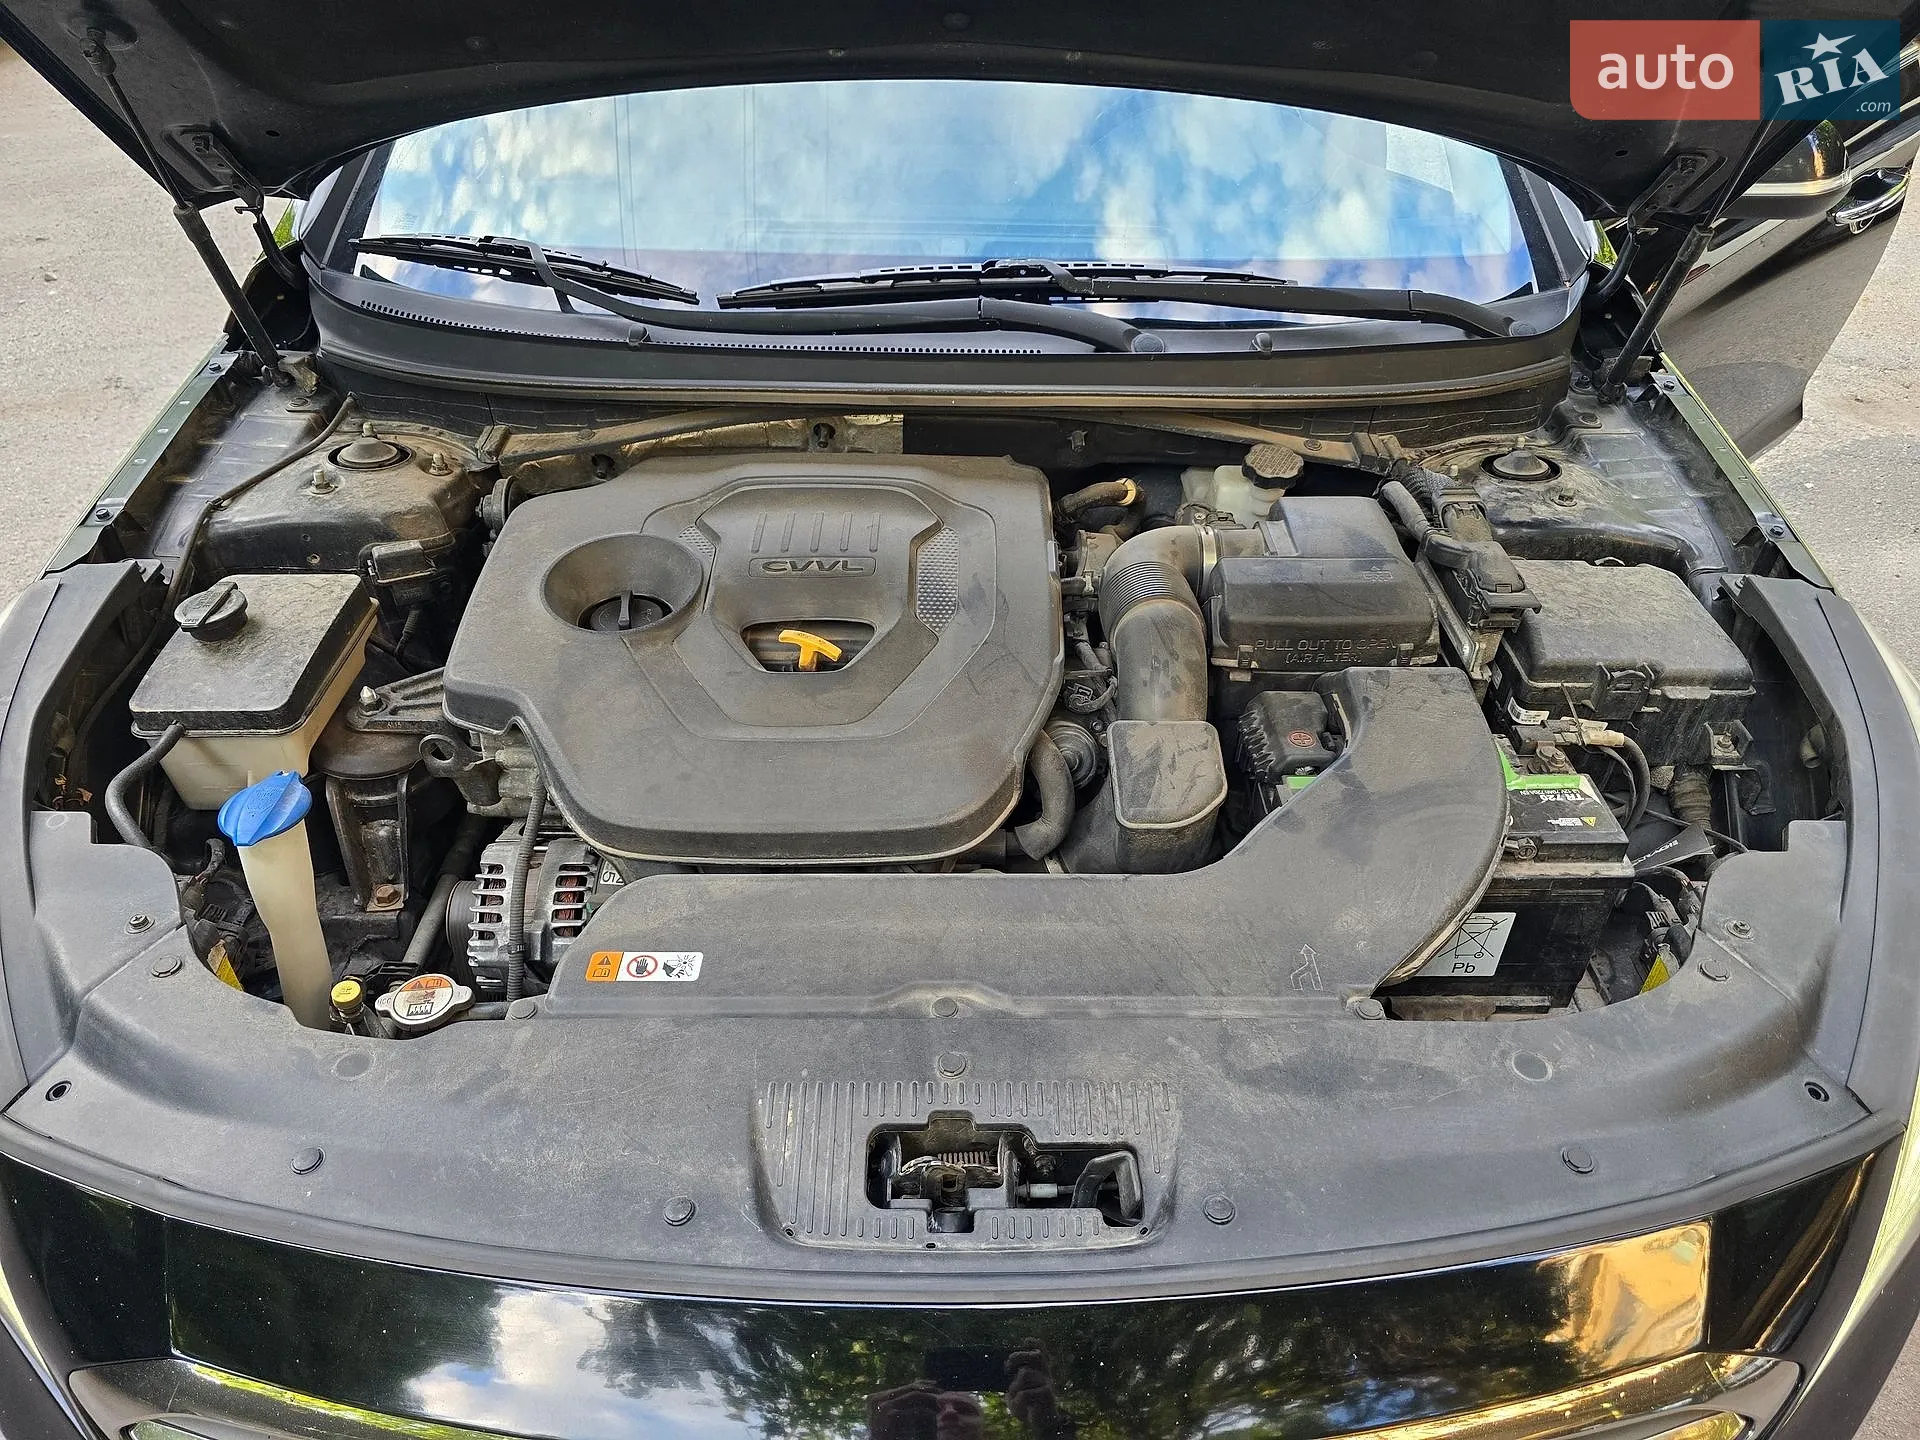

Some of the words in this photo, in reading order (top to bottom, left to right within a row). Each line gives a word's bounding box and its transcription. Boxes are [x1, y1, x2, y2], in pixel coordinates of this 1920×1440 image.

[762, 560, 864, 573] CVVL
[1254, 639, 1294, 650] PULL
[1299, 639, 1330, 650] OUT
[1334, 639, 1352, 650] TO
[1355, 638, 1398, 650] OPEN
[1565, 793, 1585, 801] TR
[1451, 962, 1476, 974] Pb
